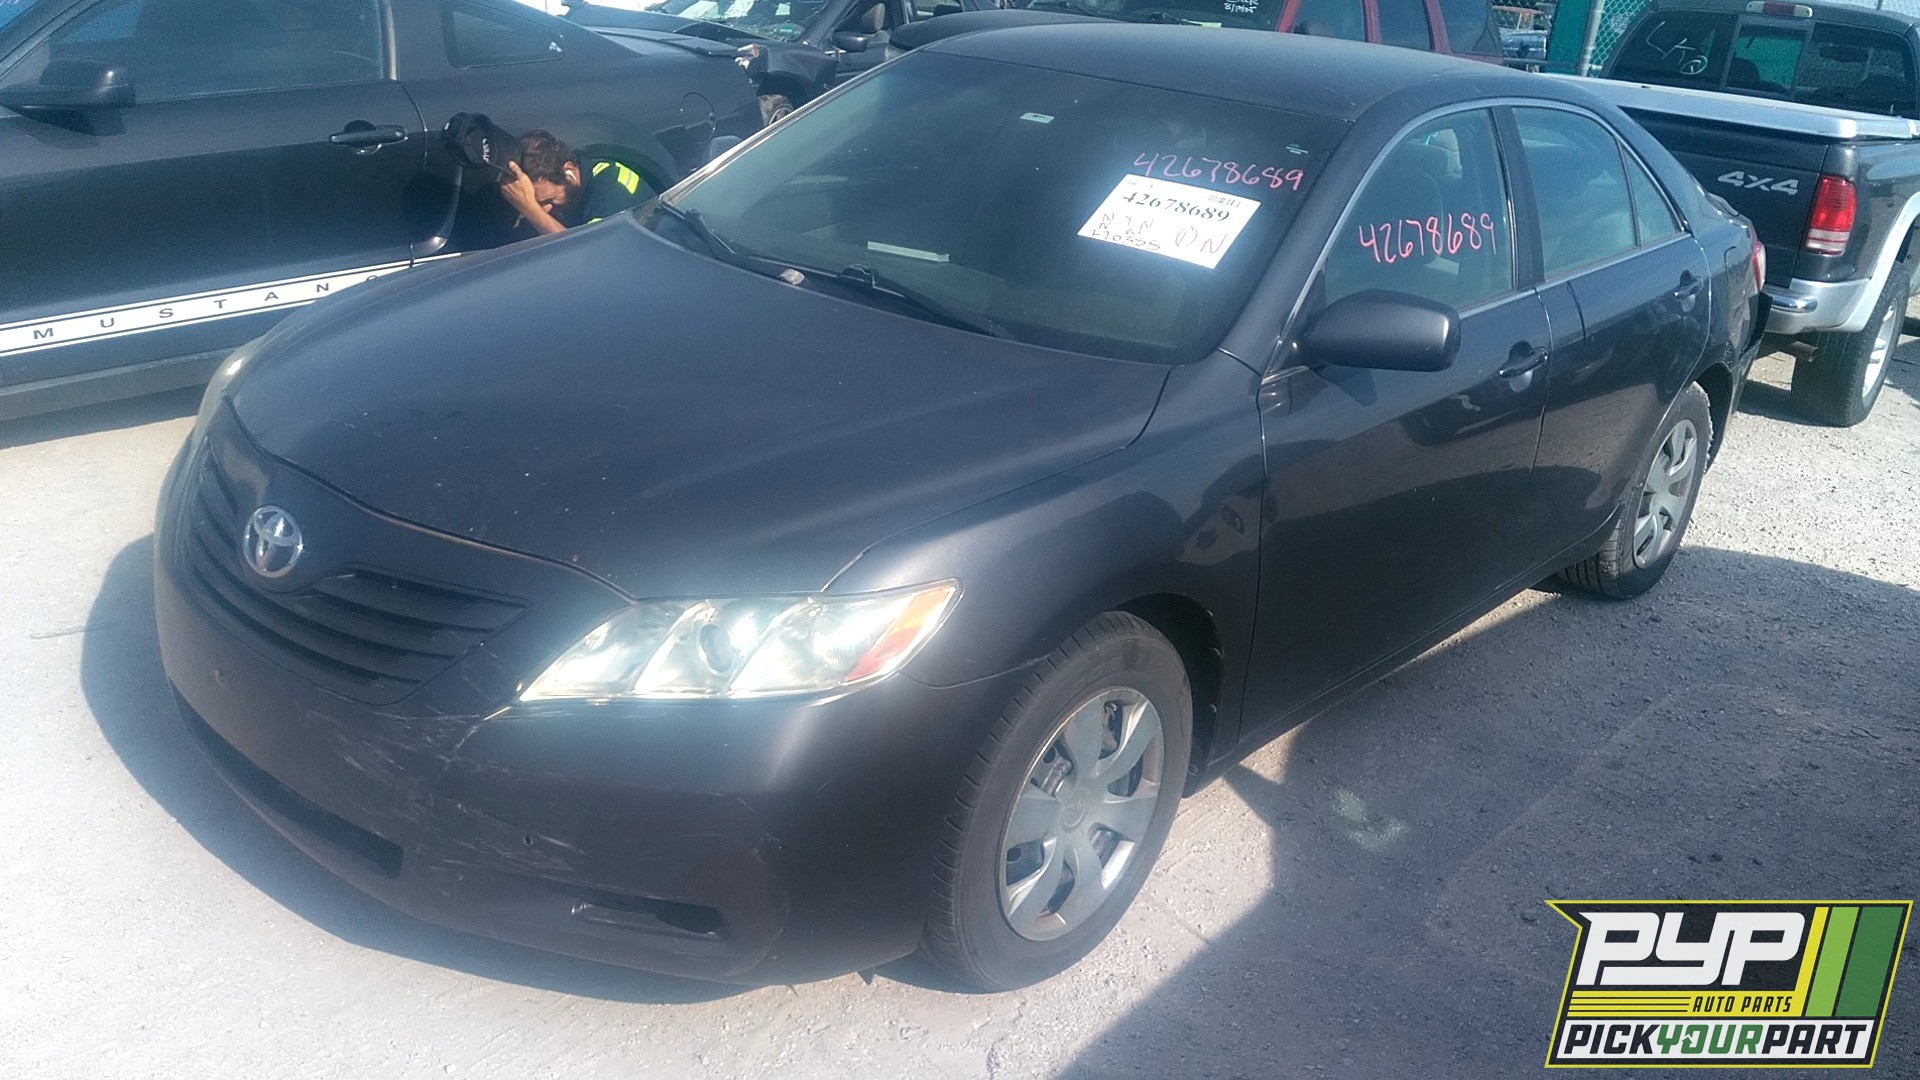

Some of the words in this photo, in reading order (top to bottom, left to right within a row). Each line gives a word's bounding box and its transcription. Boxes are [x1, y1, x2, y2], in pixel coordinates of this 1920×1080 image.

[1134, 152, 1304, 190] 42678689
[1123, 191, 1230, 222] 42678689
[1358, 213, 1497, 263] 42678689
